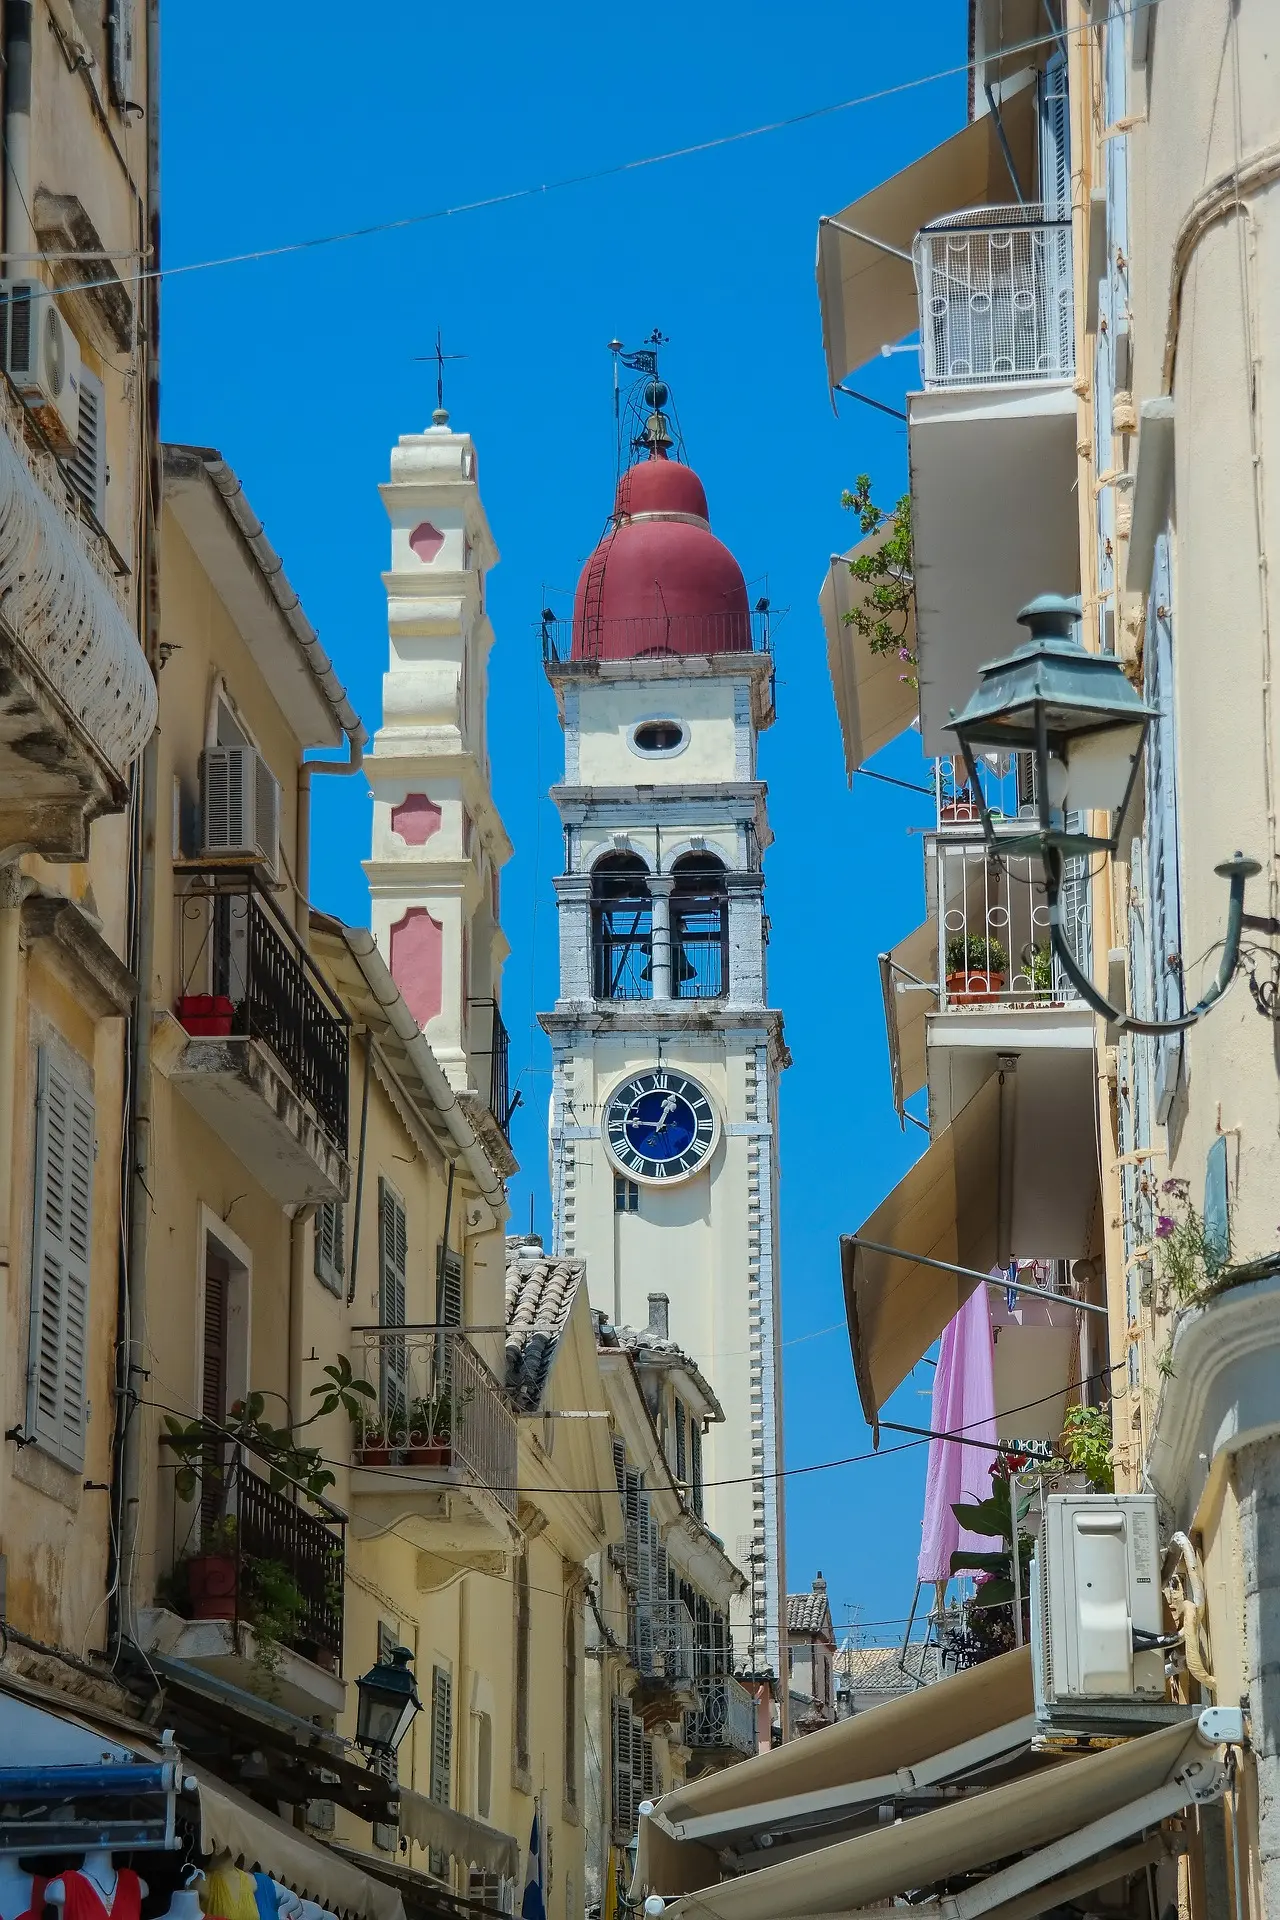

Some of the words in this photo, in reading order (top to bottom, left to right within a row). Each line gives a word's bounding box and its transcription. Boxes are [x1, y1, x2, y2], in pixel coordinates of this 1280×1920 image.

[629, 1080, 645, 1097] XI
[652, 1075, 668, 1090] XII
[678, 1081, 688, 1094] I
[692, 1097, 707, 1109] II
[698, 1119, 713, 1131] III
[612, 1138, 631, 1160] VIII
[690, 1138, 710, 1157] IIII
[629, 1155, 645, 1174] VII
[655, 1163, 667, 1177] VI
[679, 1157, 691, 1172] V
